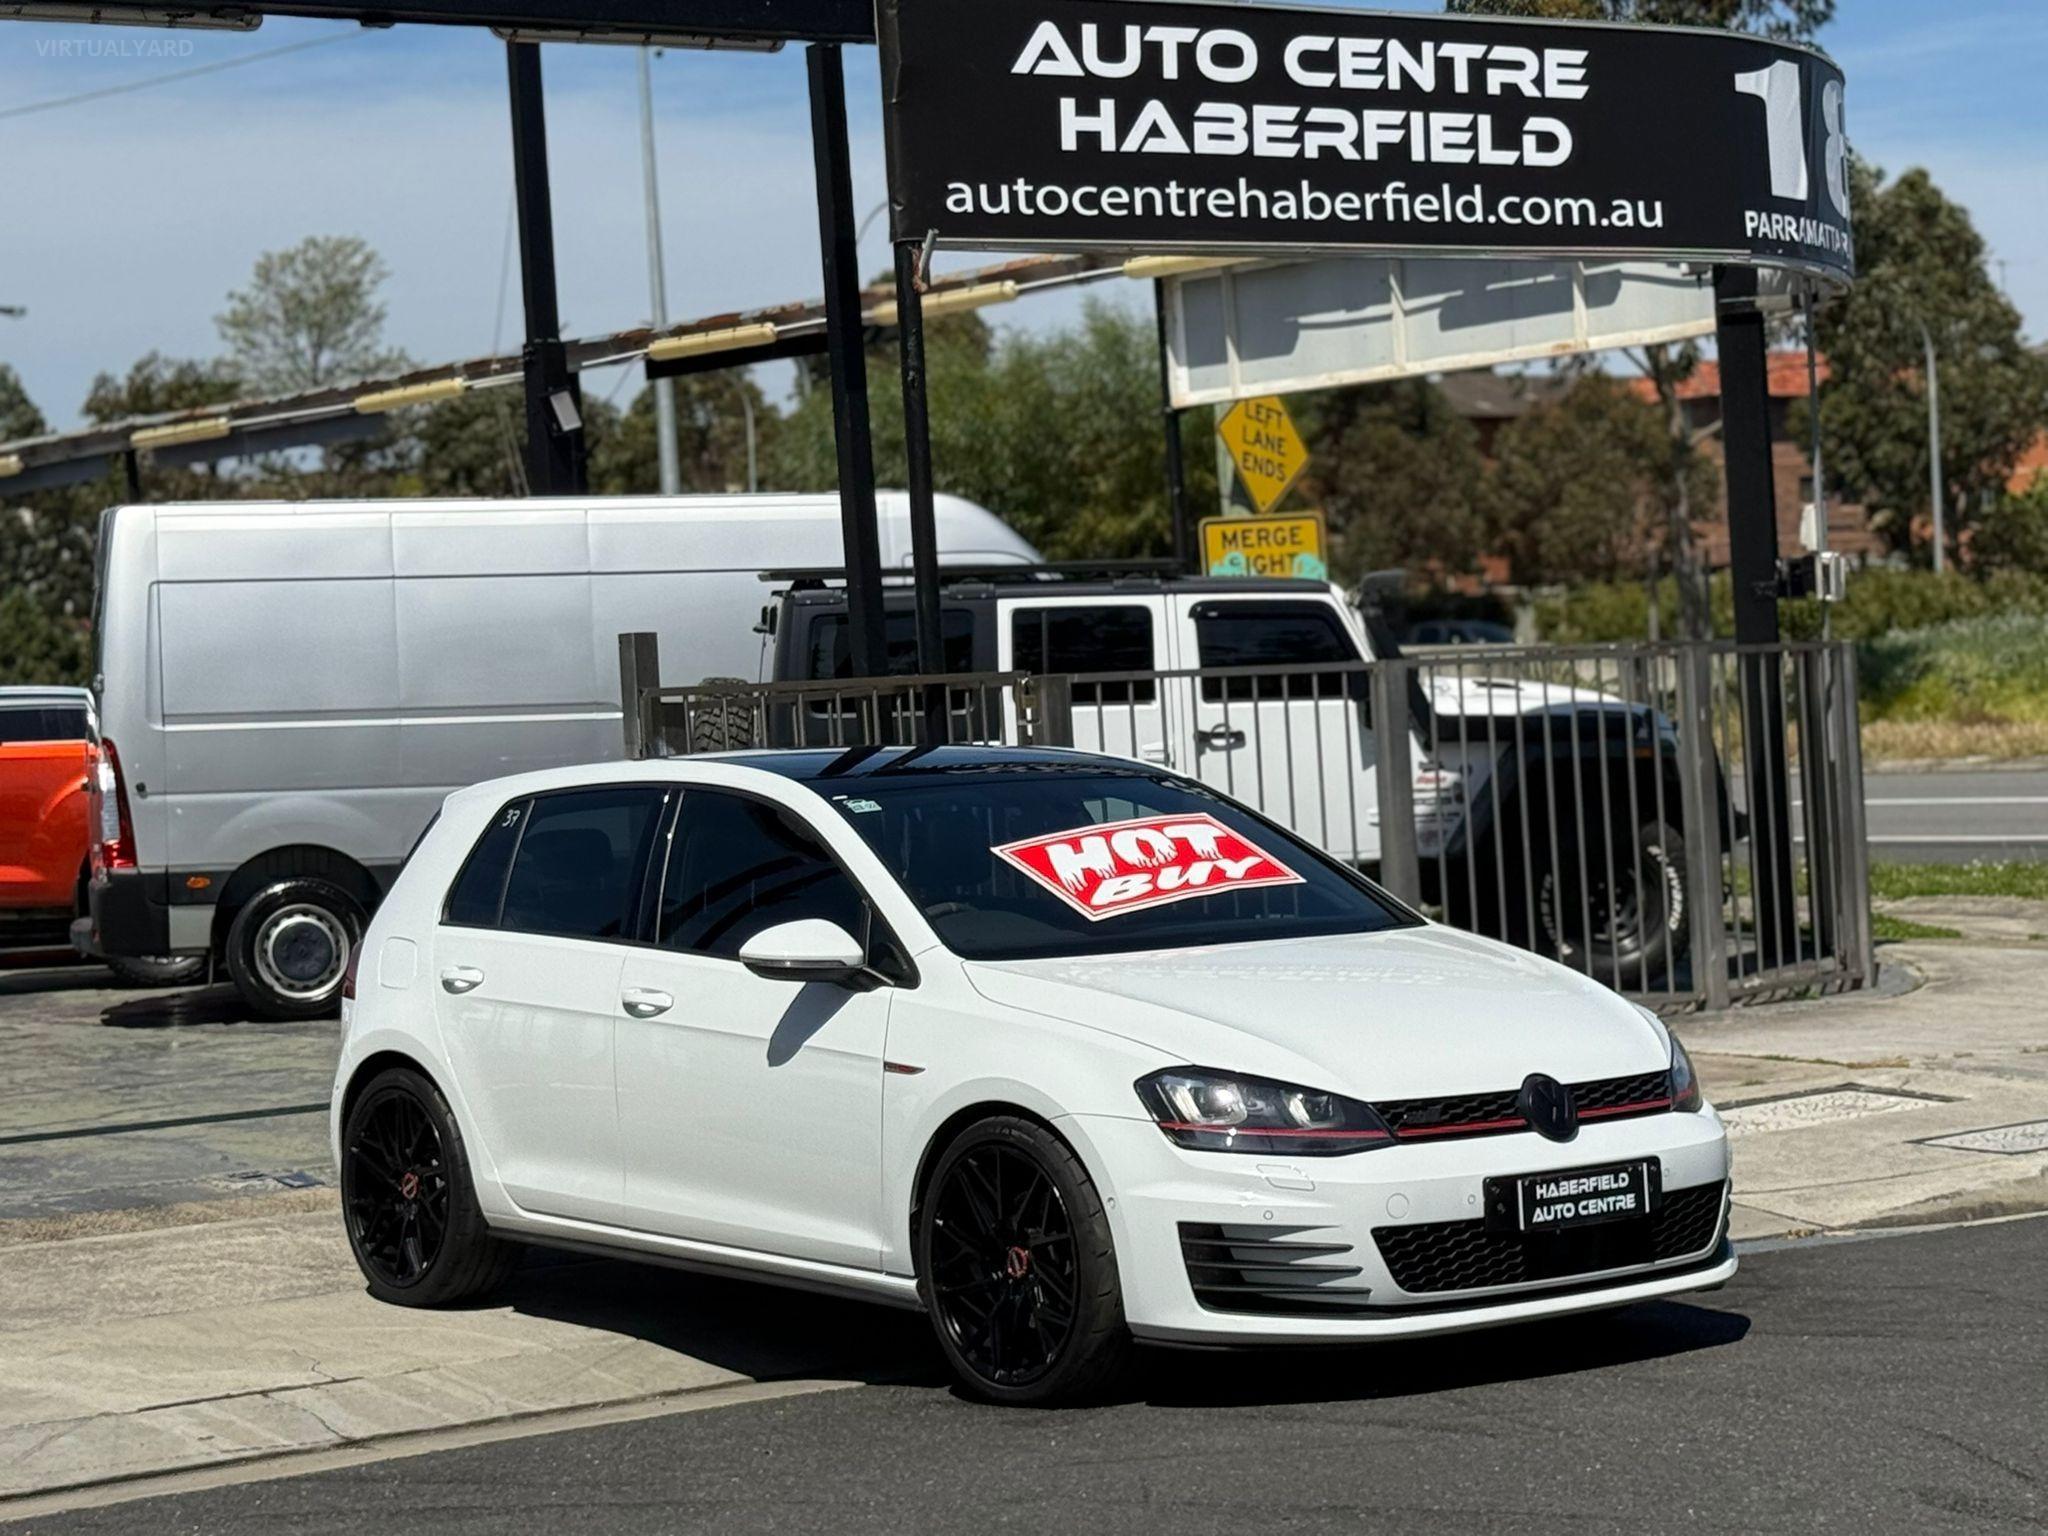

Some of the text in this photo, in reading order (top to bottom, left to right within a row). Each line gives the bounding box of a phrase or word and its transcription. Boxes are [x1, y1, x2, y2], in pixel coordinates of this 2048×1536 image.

[1010, 20, 1590, 100] AUTO CENTRE
[1059, 97, 1573, 167] HABERFIELD
[945, 177, 1664, 227] autocentrehaberfield.com.au
[1744, 210, 1840, 253] PARRAMATTA
[1244, 399, 1282, 429] LEFT
[1242, 425, 1287, 458] LANE
[1242, 451, 1287, 482] ENDS
[1221, 525, 1303, 549] MERGE
[1045, 823, 1227, 894] HOT
[1090, 856, 1264, 906] BUY
[1535, 1172, 1630, 1200] HABERFIELD
[1532, 1193, 1637, 1223] AUTO CENTRE
